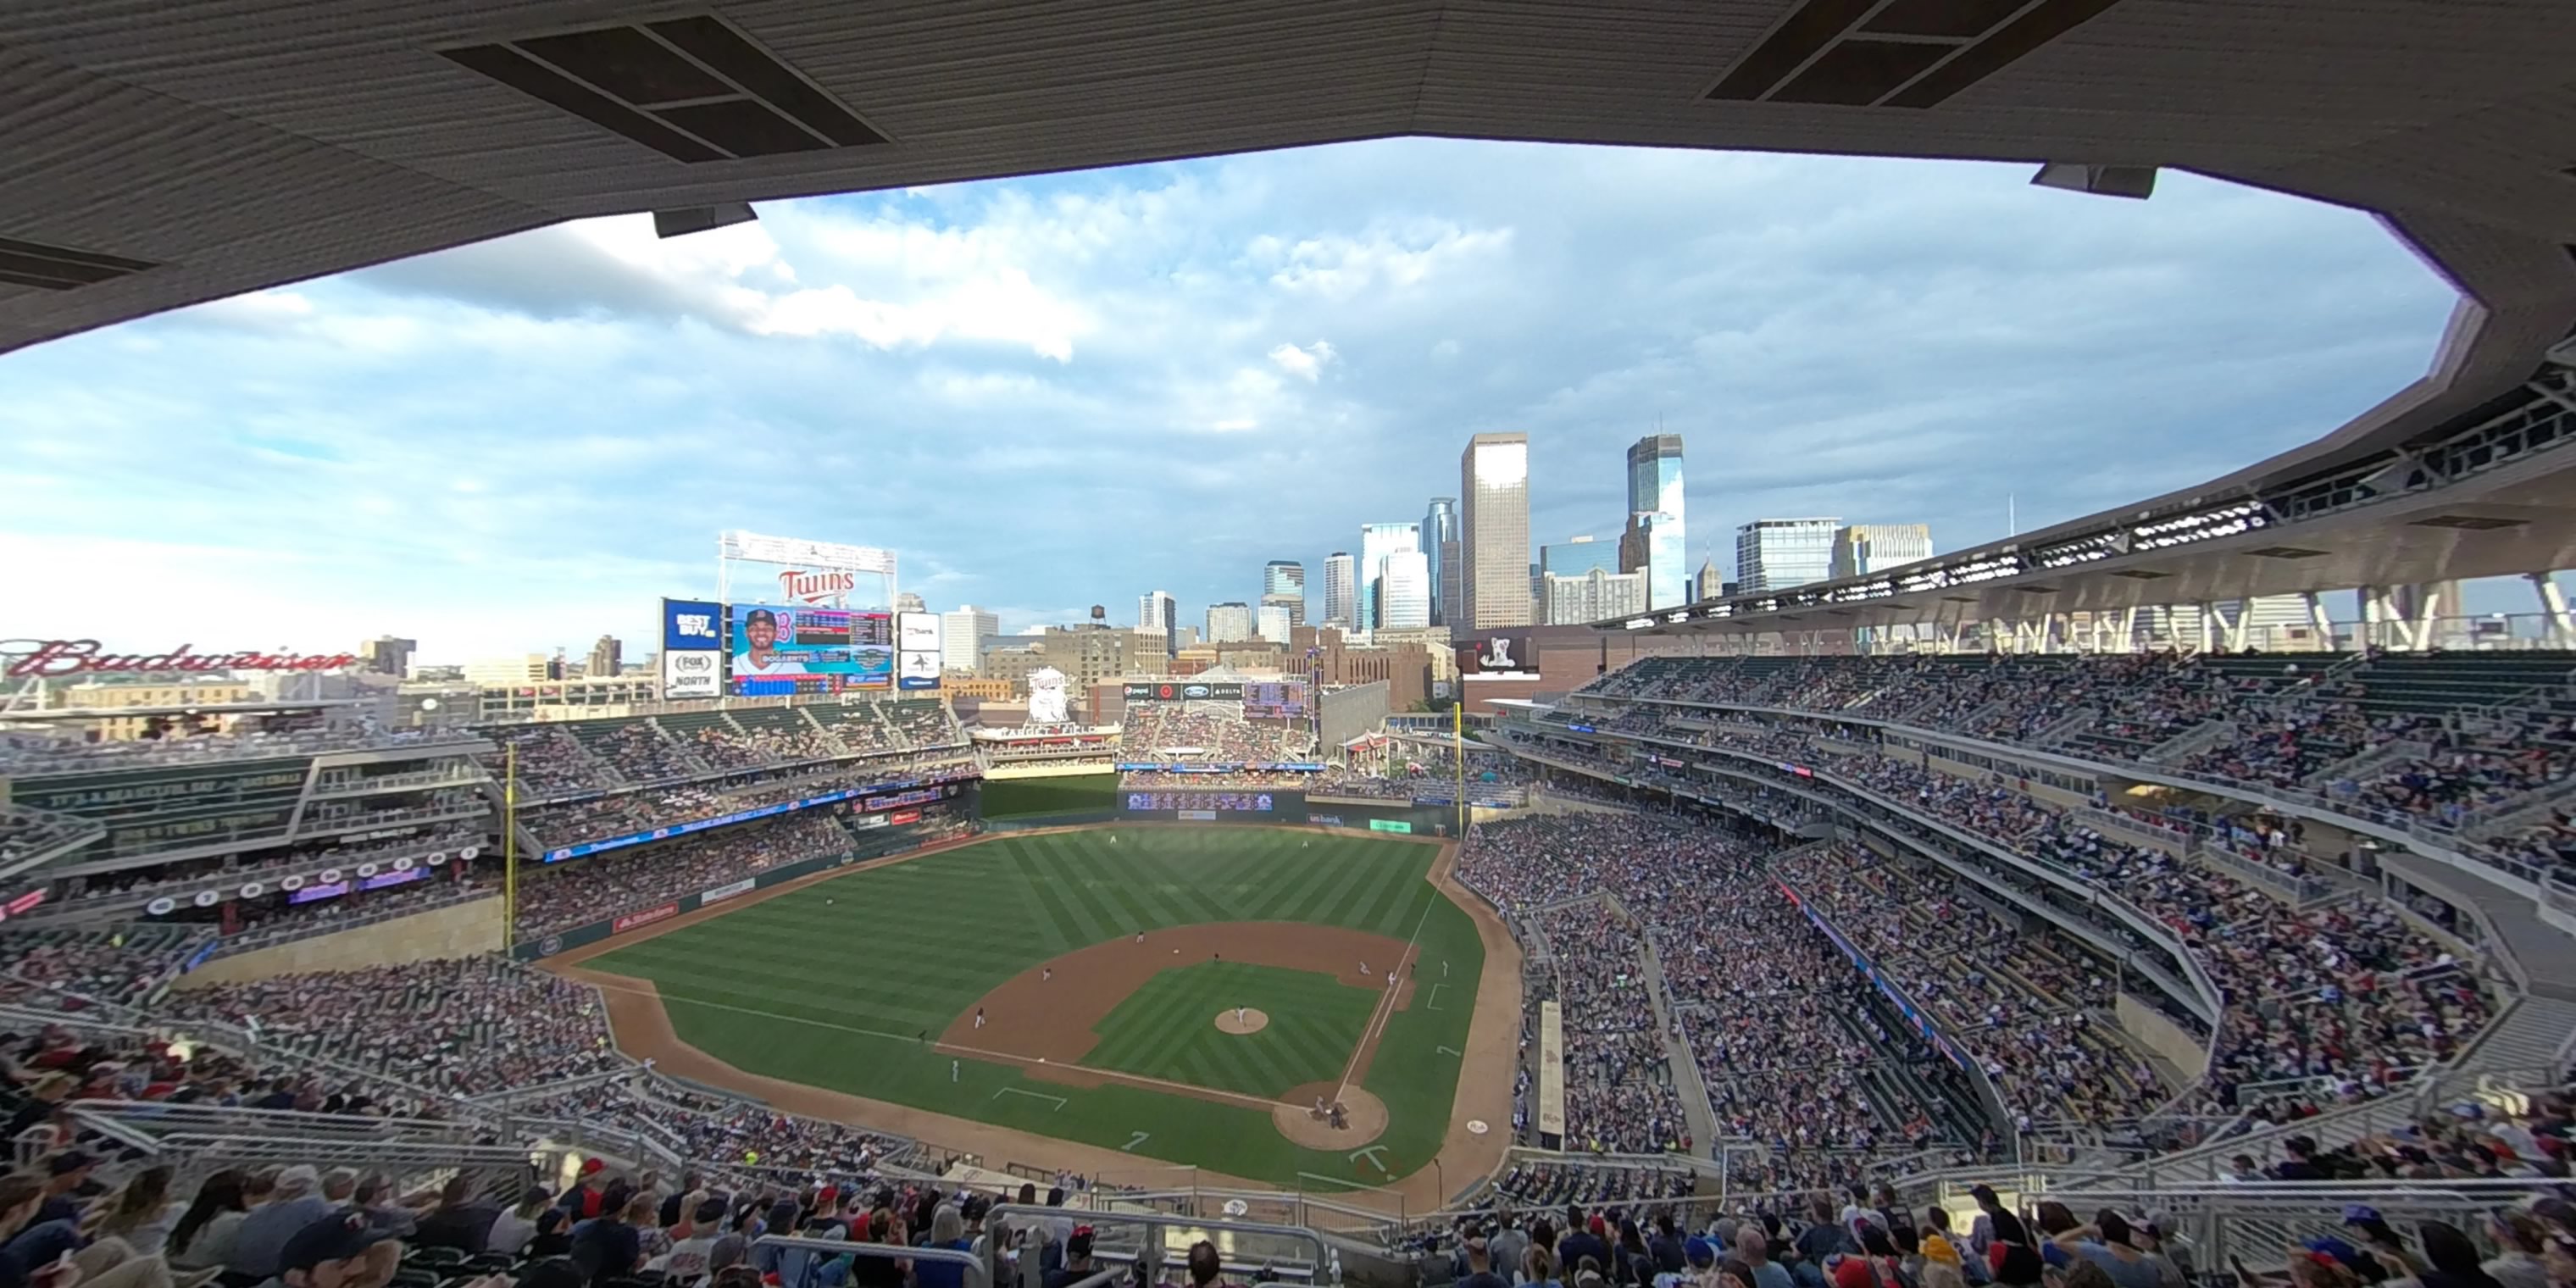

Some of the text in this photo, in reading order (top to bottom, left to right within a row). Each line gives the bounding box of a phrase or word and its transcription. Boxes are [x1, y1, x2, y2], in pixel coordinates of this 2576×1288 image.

[779, 570, 855, 599] Twins
[676, 613, 712, 625] BEST
[679, 625, 707, 636] BUY
[2, 639, 356, 677] Budweiser
[683, 657, 703, 666] FOX
[676, 676, 711, 686] NORTH
[1031, 677, 1064, 690] Twins
[1002, 723, 1099, 737] TARGET FIELD
